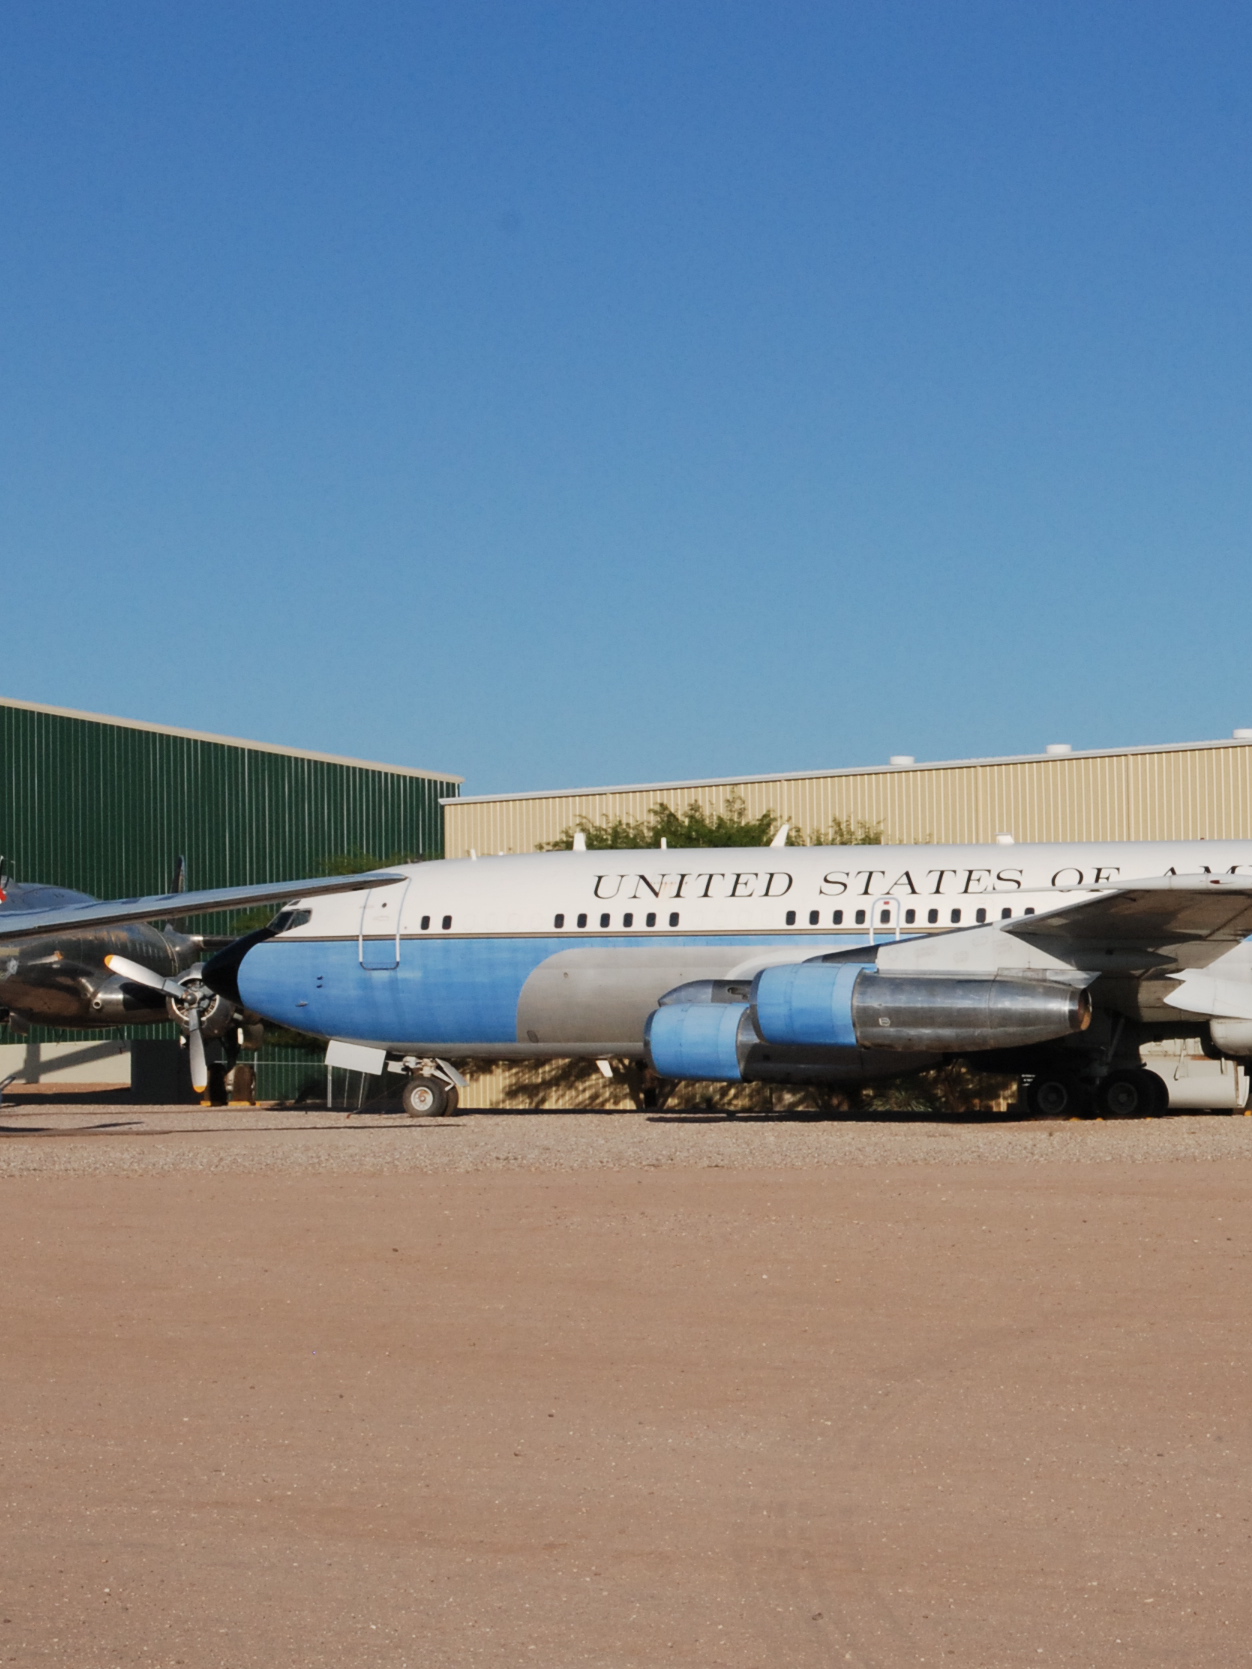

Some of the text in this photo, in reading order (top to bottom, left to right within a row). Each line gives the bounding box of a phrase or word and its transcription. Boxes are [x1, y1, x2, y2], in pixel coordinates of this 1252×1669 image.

[593, 871, 794, 900] UNITED
[818, 868, 1024, 897] STATES
[1051, 866, 1121, 893] OF
